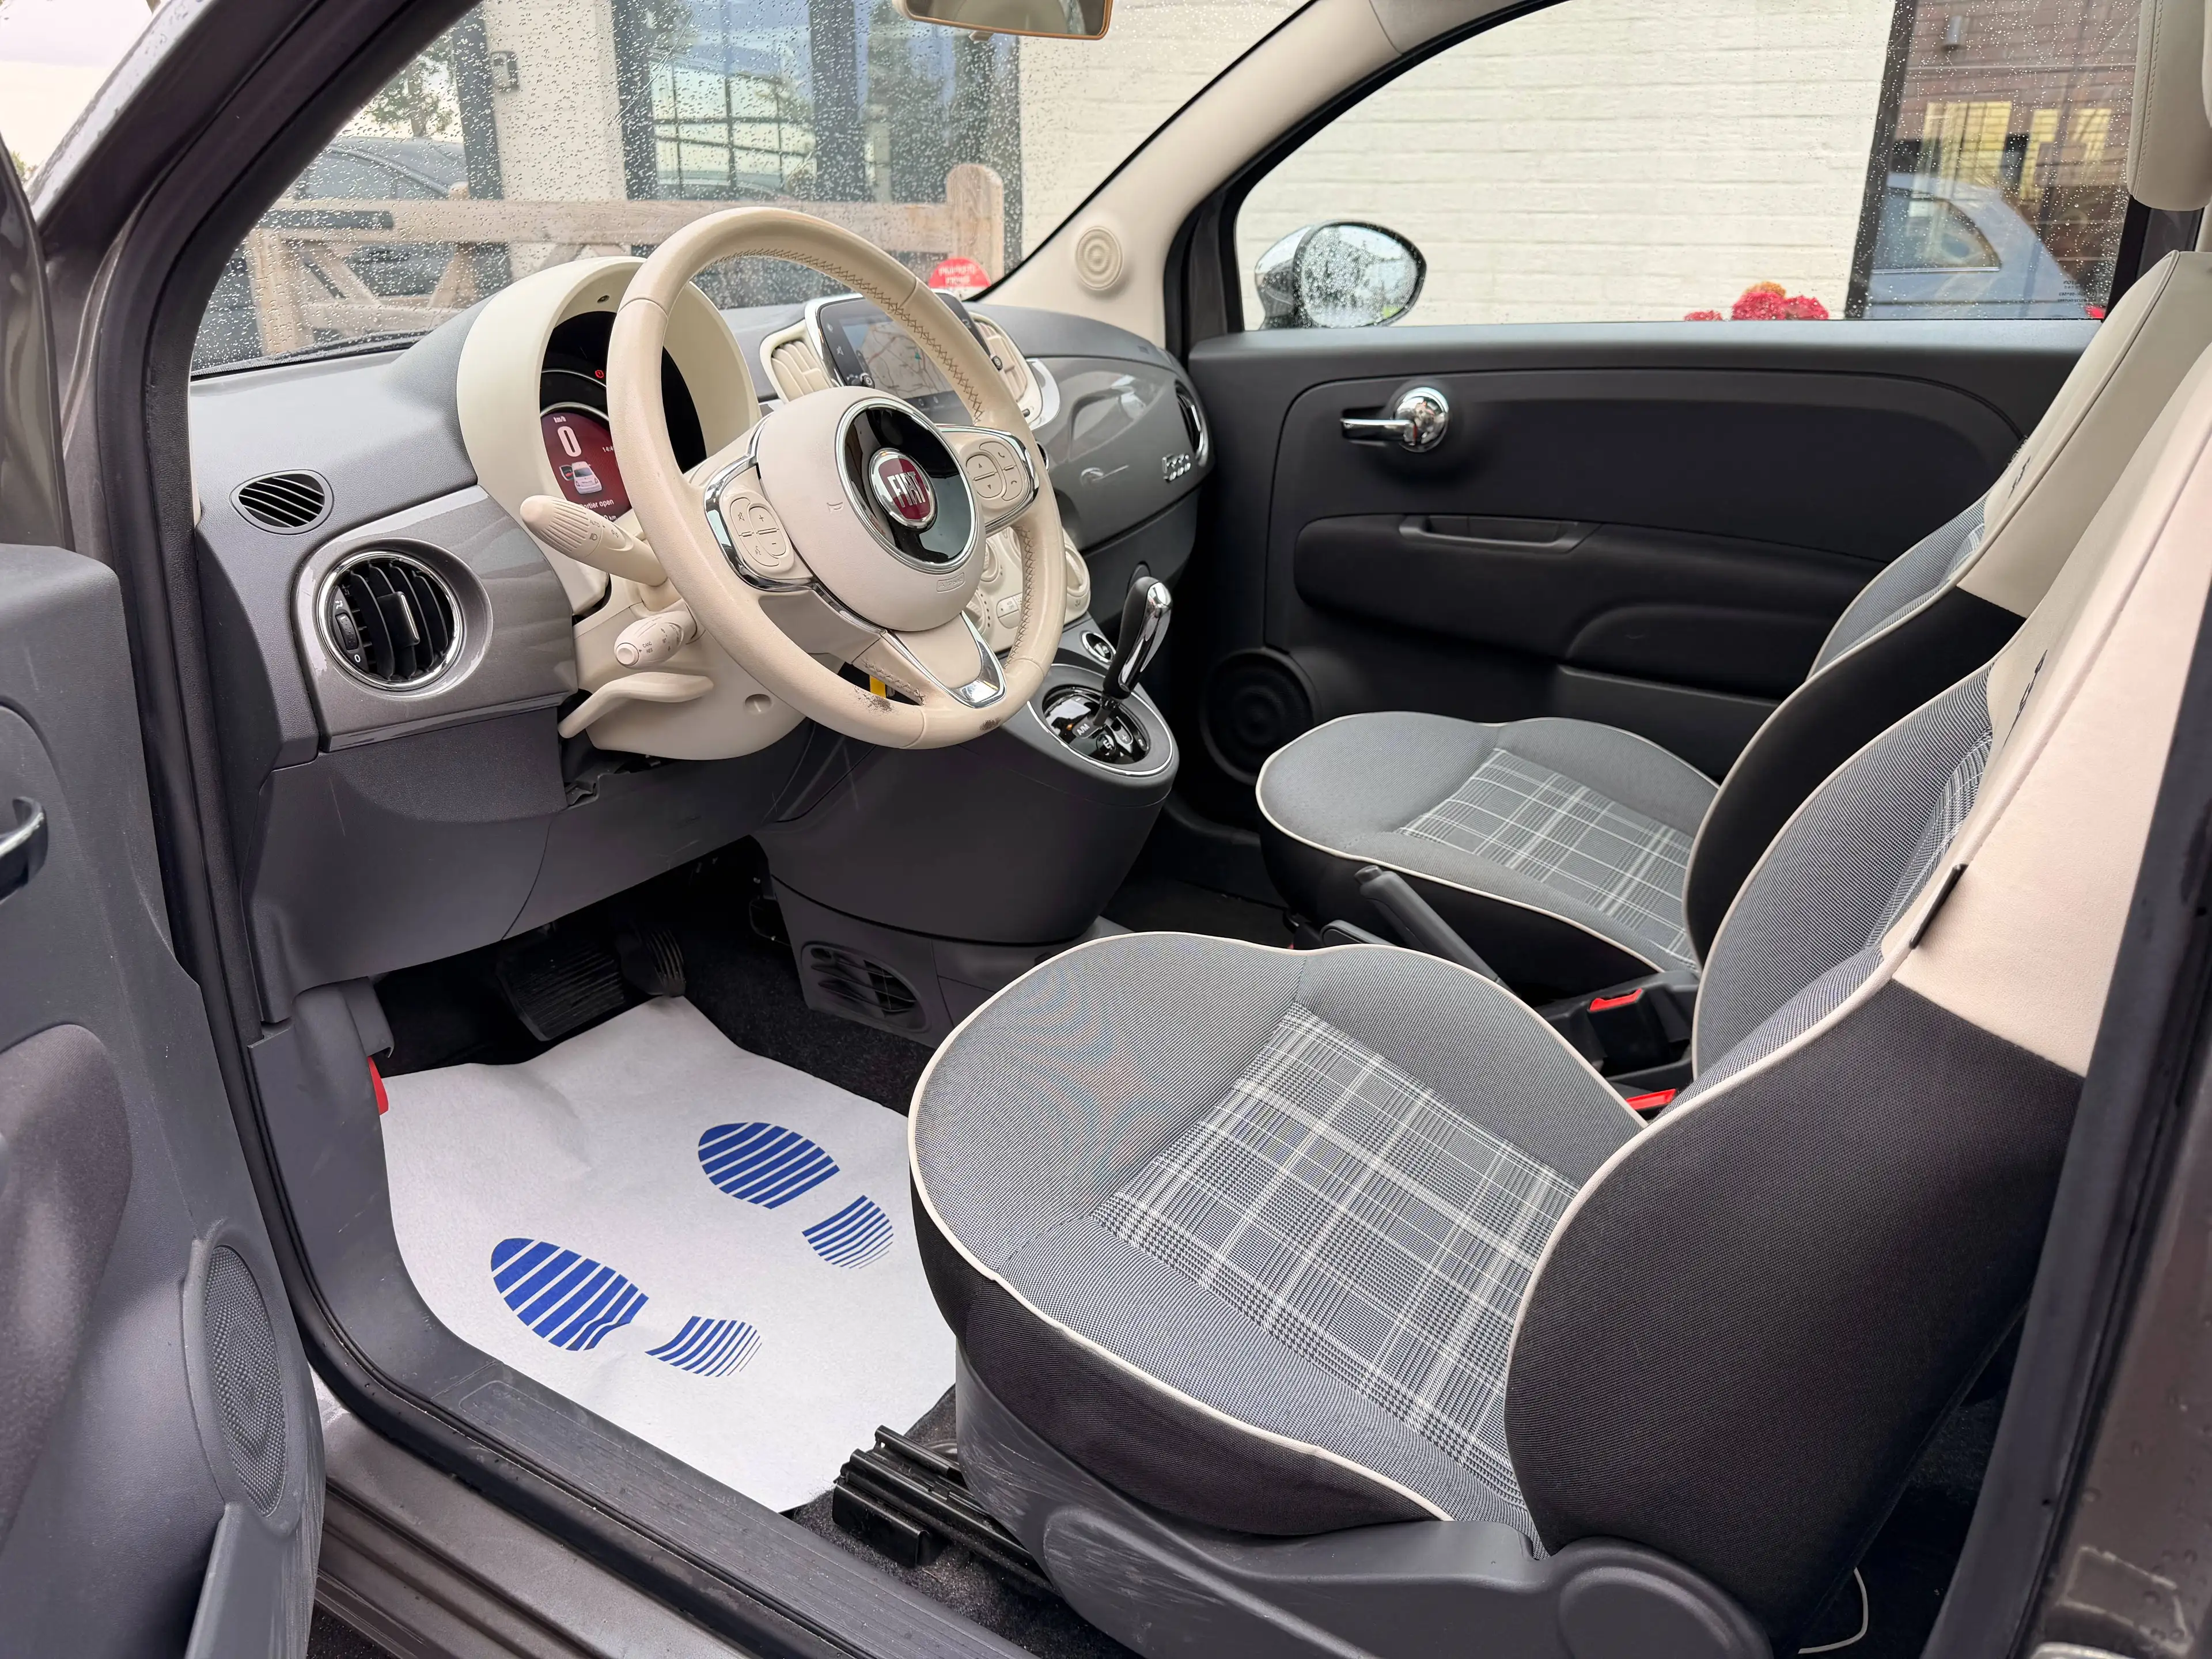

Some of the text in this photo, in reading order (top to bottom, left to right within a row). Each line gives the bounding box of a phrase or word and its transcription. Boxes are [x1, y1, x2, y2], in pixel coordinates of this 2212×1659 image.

[557, 426, 582, 457] 0
[887, 471, 926, 507] FIAT
[599, 499, 614, 507] open
[589, 520, 600, 528] AUTO
[1077, 724, 1090, 736] A/M
